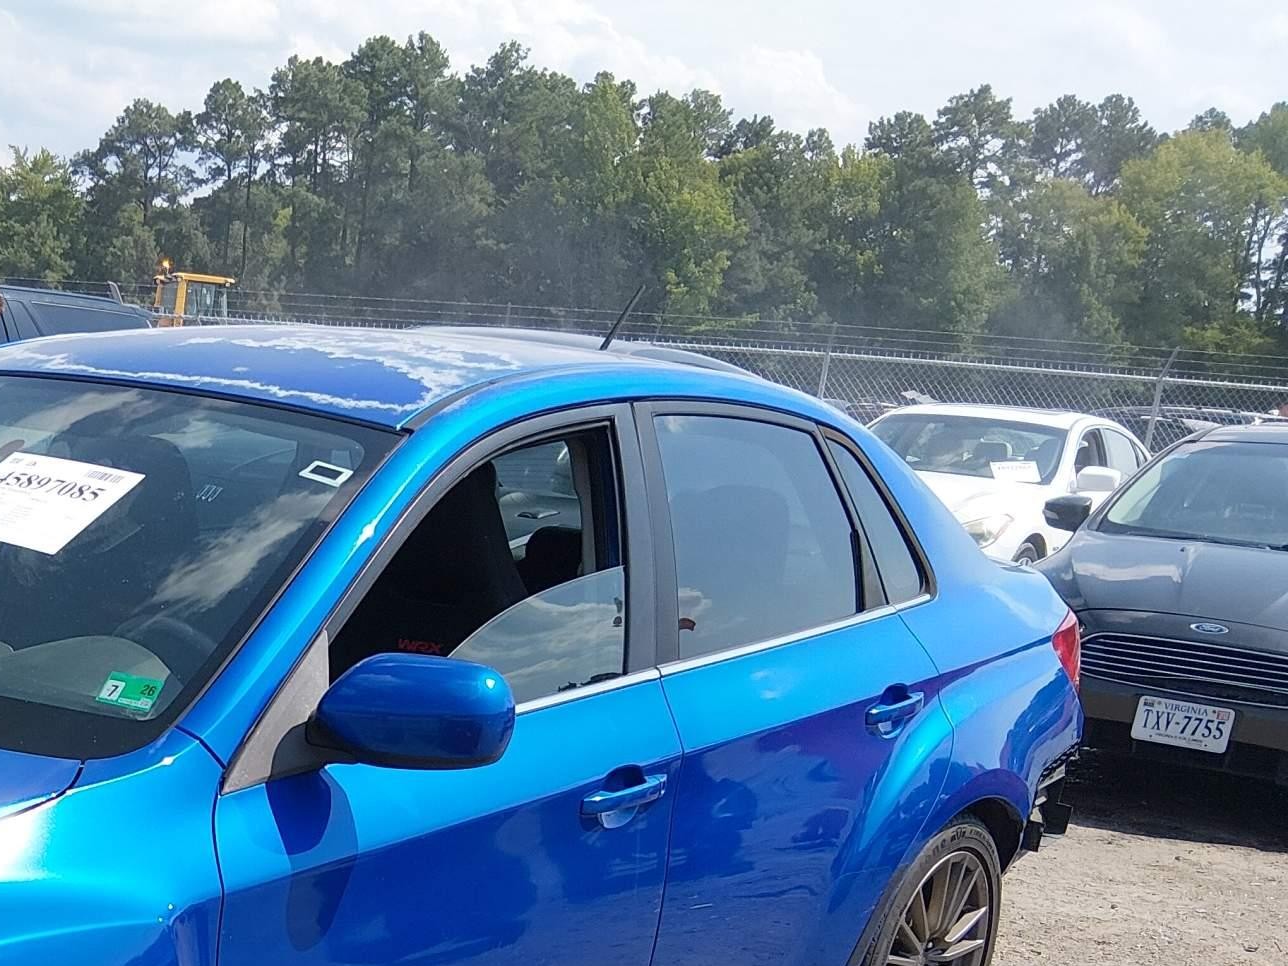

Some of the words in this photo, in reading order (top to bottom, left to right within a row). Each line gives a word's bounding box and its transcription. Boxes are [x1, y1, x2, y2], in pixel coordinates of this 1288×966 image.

[108, 684, 119, 697] 7
[140, 684, 157, 697] 26
[1163, 702, 1209, 717] VIRGINIA
[1142, 708, 1226, 740] TXV-7755
